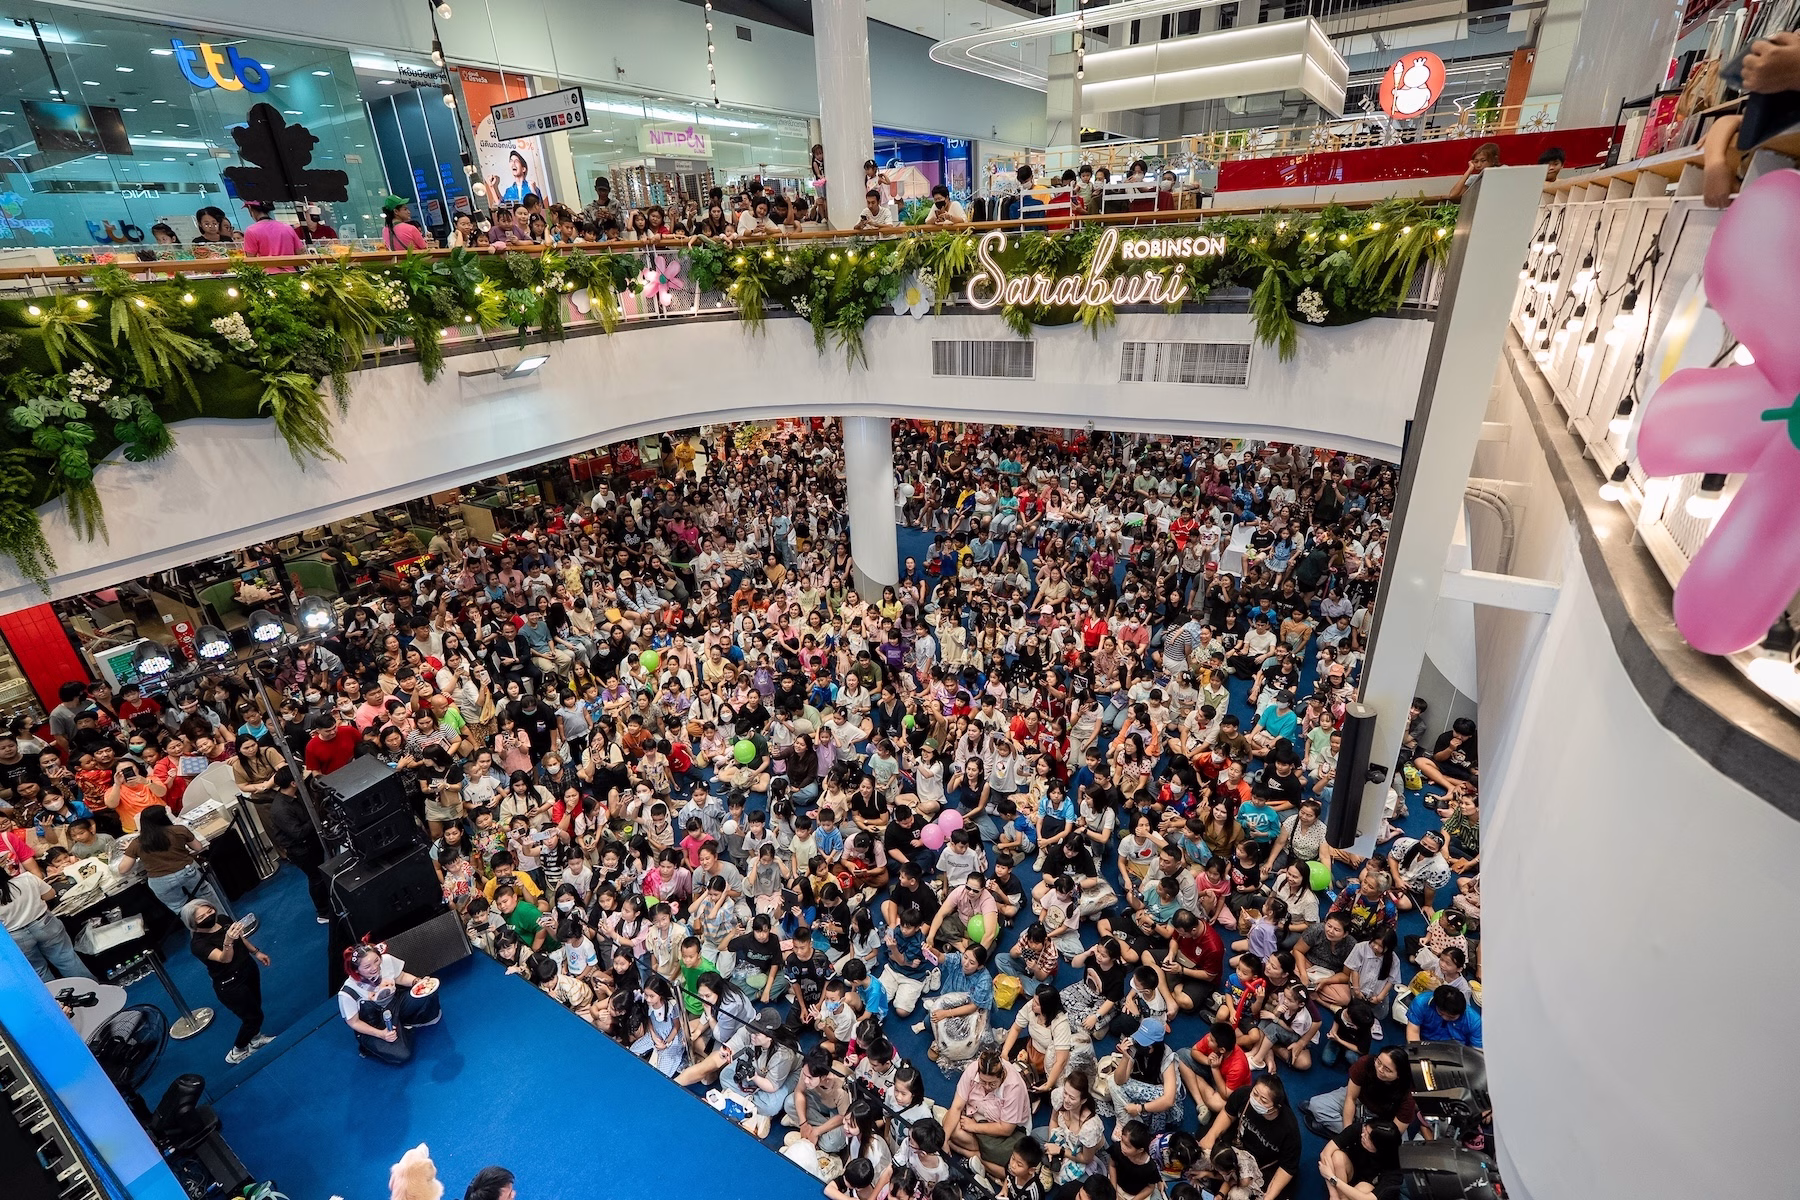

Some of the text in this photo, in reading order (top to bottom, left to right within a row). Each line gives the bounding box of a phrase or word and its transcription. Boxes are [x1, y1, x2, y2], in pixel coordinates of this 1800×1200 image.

[170, 38, 270, 93] ttb
[86, 219, 145, 243] ttb
[1121, 235, 1227, 260] ROBINSON
[967, 227, 1191, 310] Saraburi
